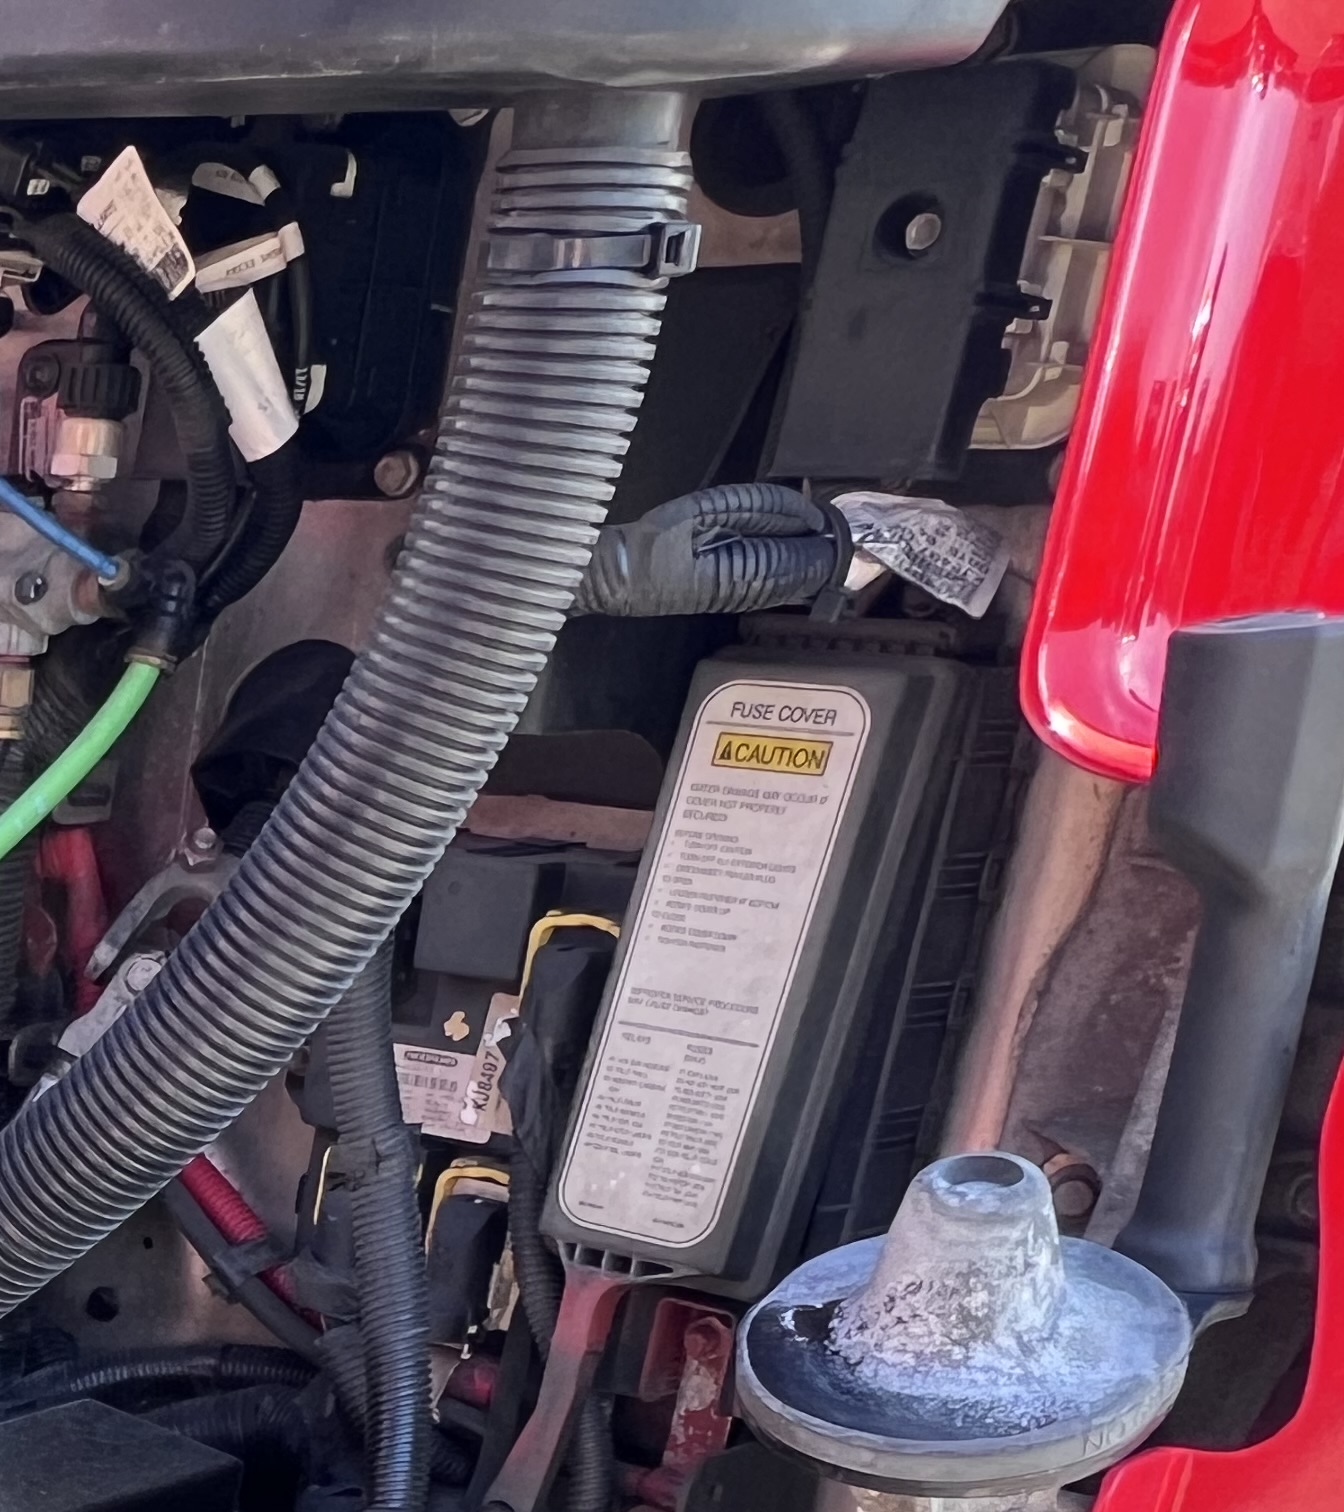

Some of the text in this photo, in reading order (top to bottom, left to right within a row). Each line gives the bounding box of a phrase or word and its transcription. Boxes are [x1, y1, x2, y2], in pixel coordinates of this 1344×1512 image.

[730, 701, 838, 727] FUSE COVER
[734, 743, 825, 770] CAUTION
